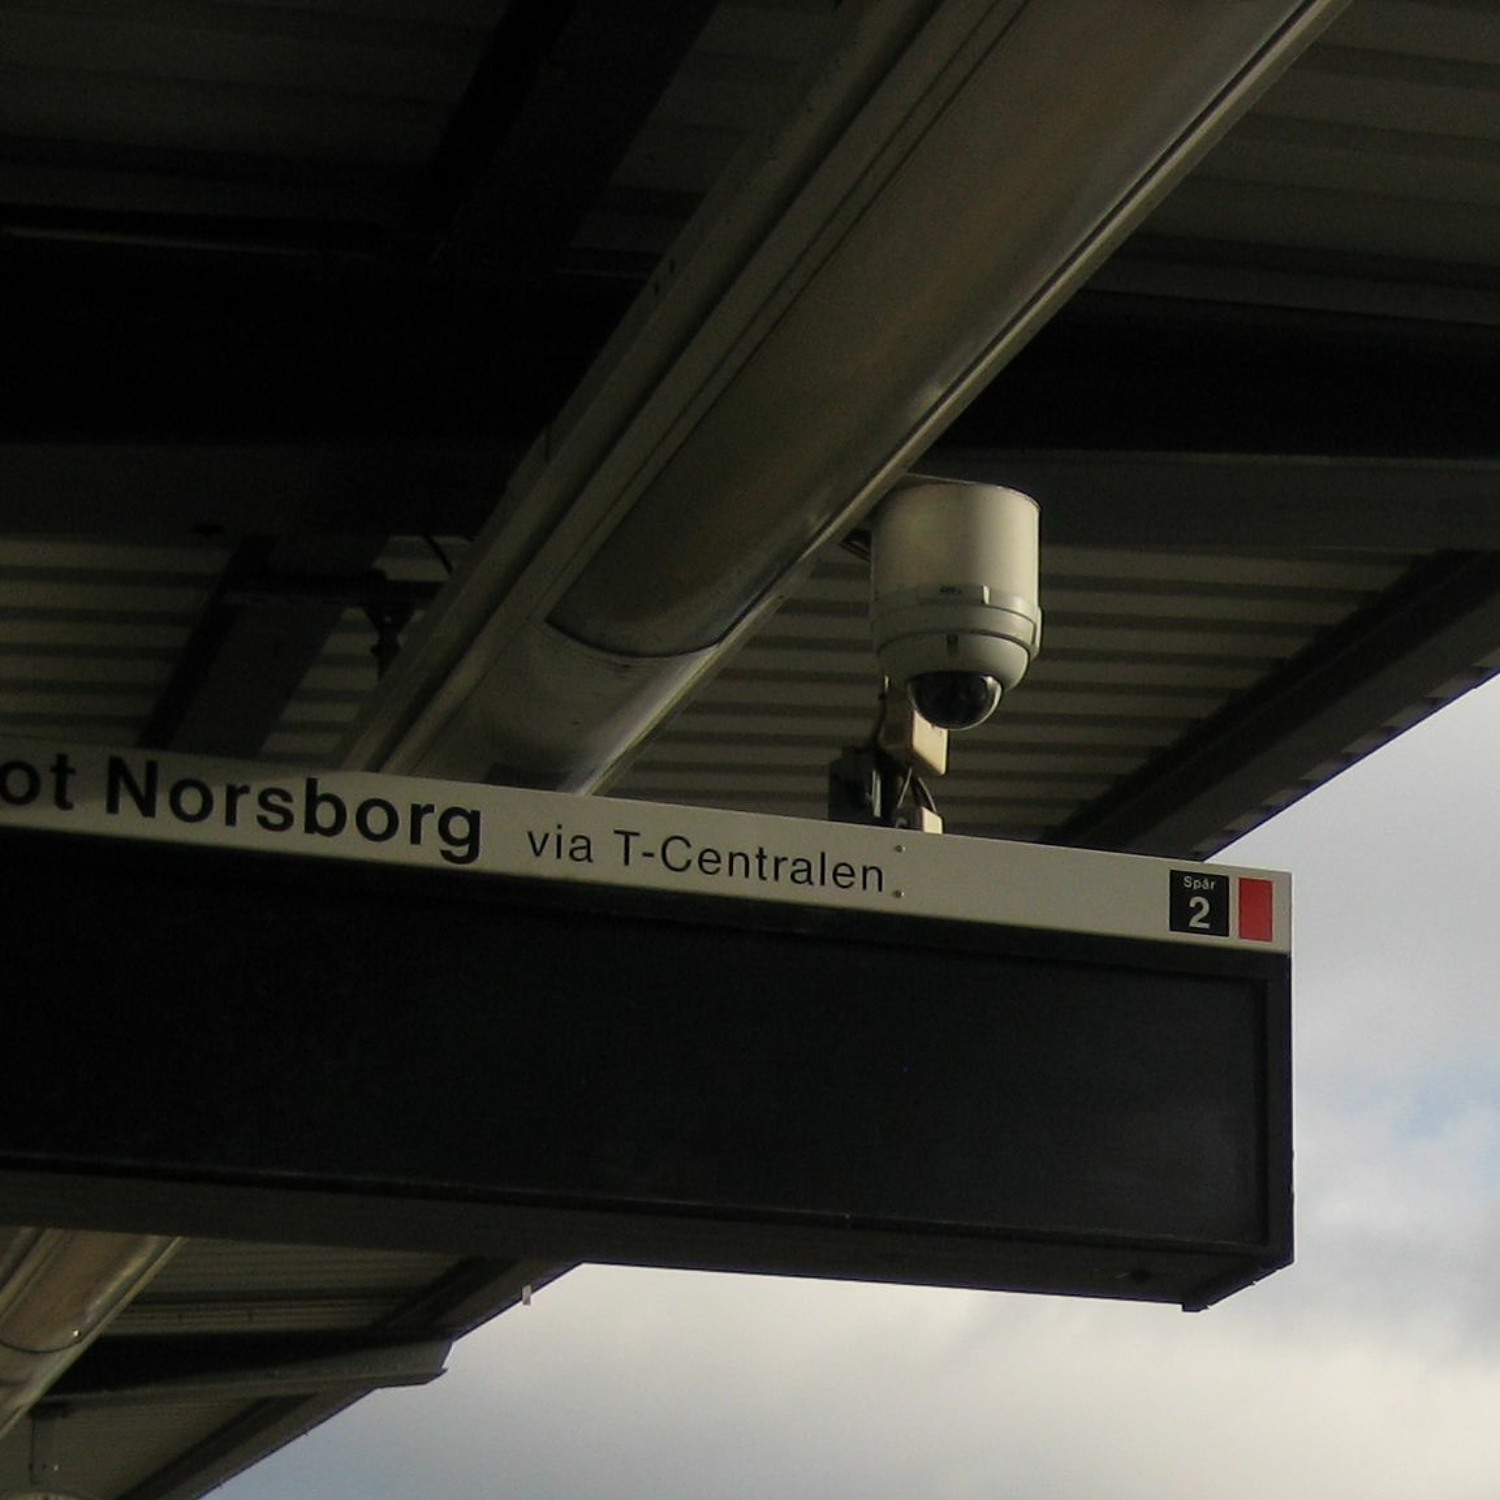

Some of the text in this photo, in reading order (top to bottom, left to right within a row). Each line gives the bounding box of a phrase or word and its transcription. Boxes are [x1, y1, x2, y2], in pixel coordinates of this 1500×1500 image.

[105, 755, 482, 865] Norsborg
[527, 823, 594, 864] via
[613, 829, 885, 893] T-Centralen
[1184, 876, 1216, 890] Spår
[1189, 896, 1210, 929] 2
